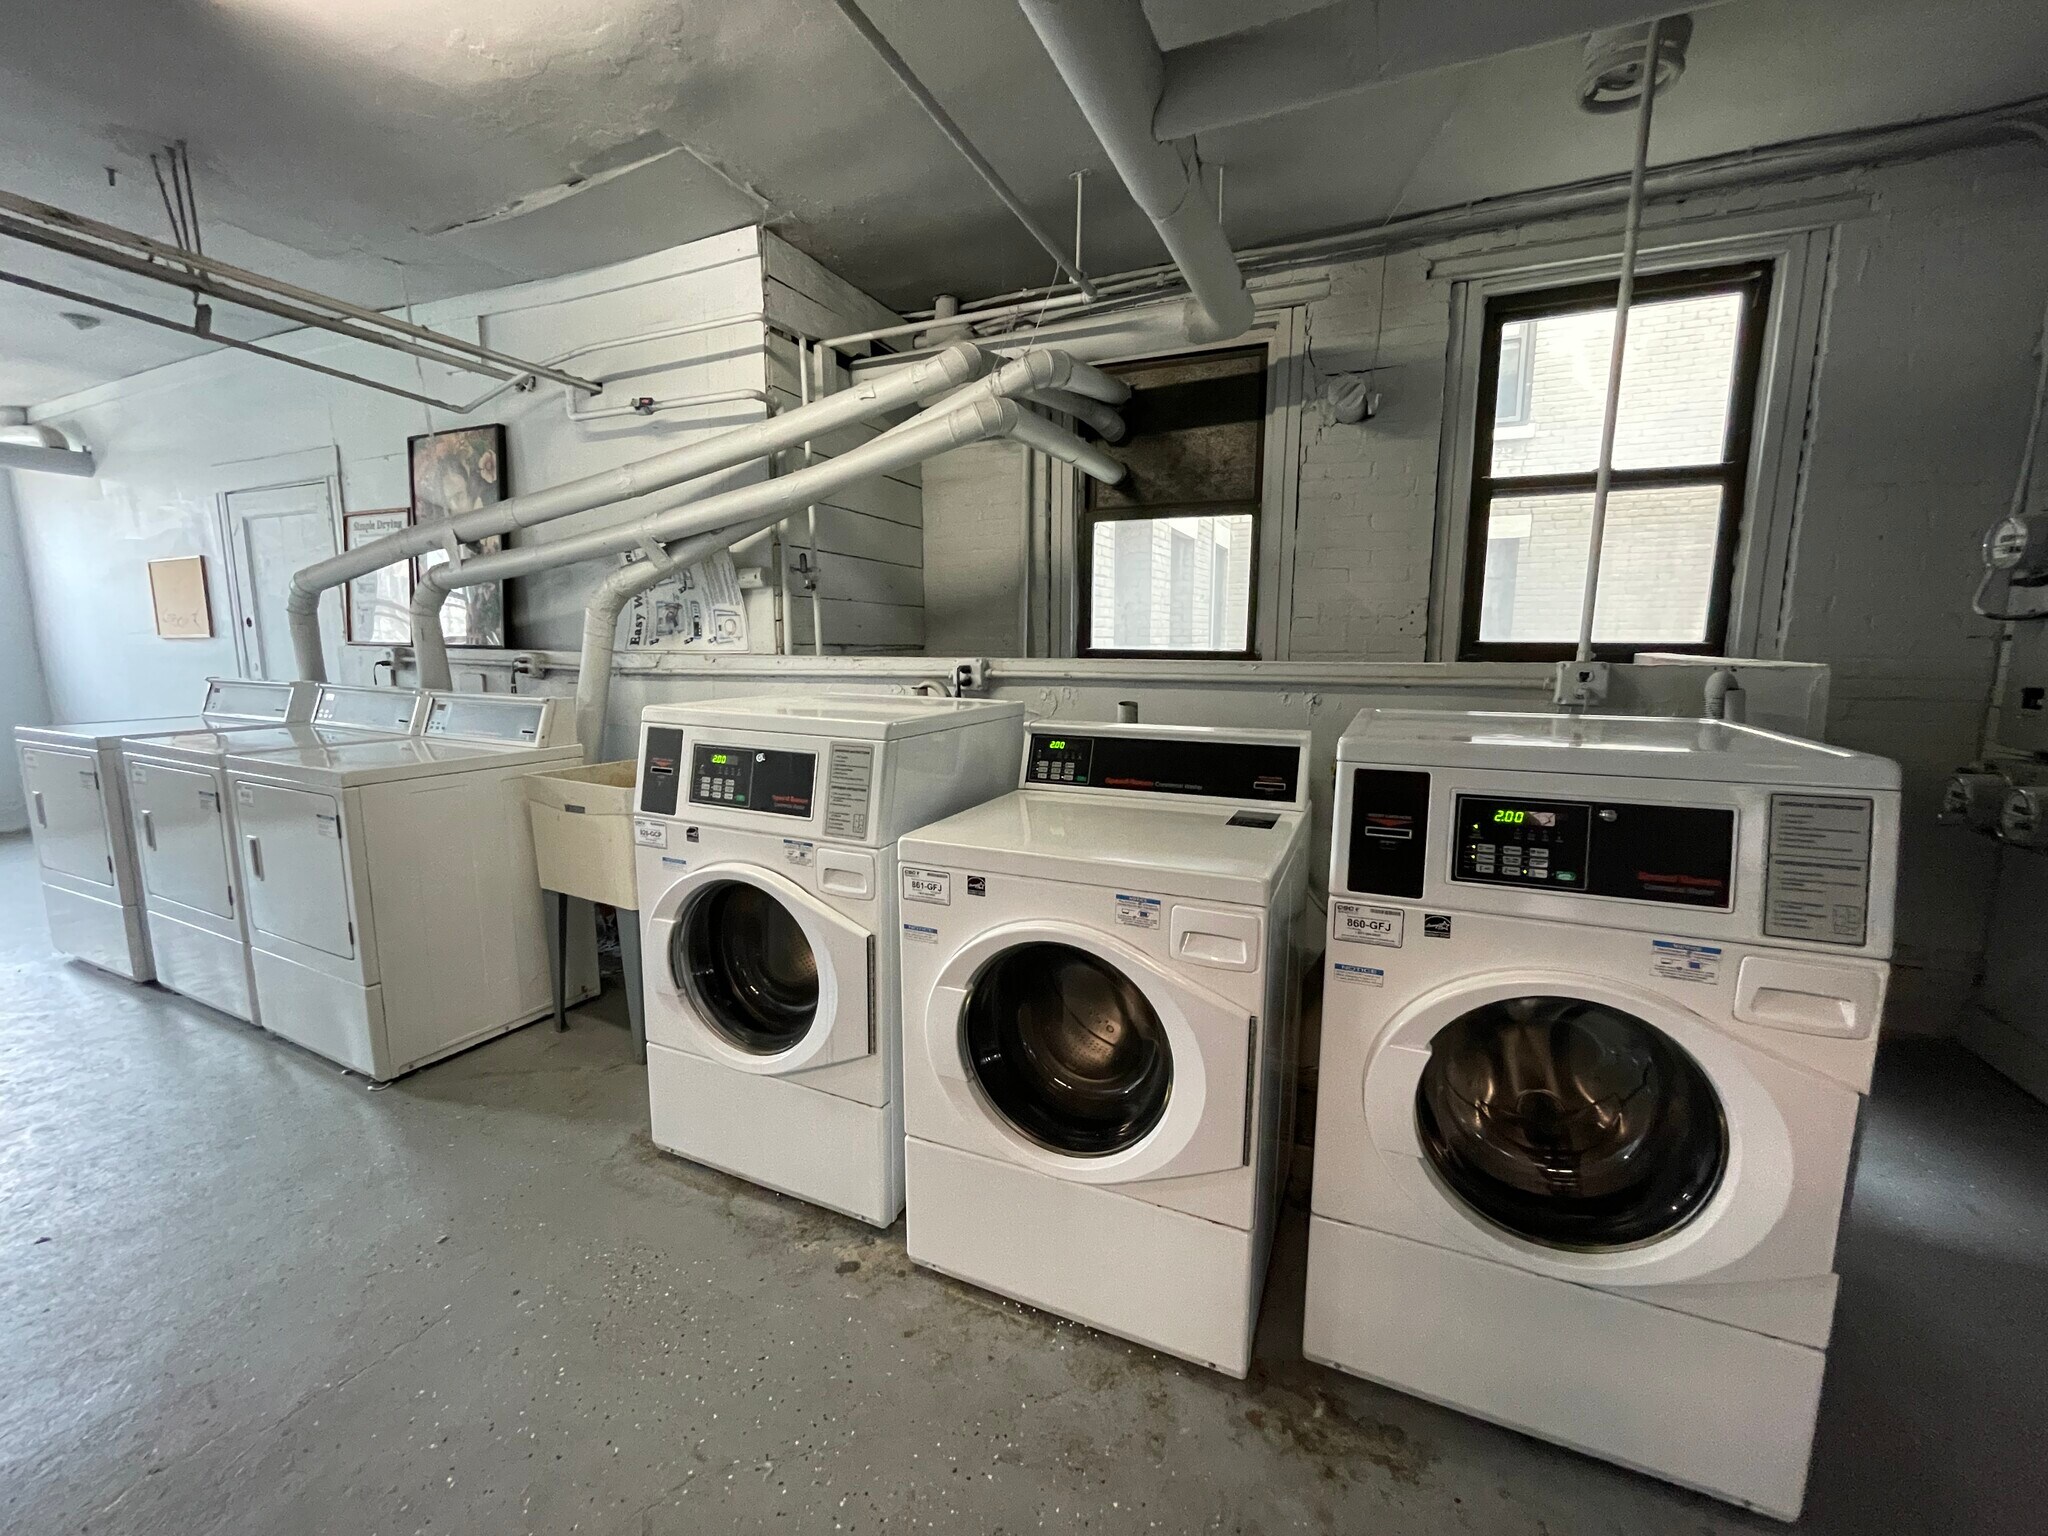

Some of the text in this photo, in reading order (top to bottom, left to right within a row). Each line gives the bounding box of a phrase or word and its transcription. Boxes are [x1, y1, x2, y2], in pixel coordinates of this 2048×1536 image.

[353, 519, 402, 533] Simple Drying
[630, 613, 646, 645] Easy
[1494, 810, 1524, 823] 2.00
[912, 881, 942, 892] 861-GFJ
[1346, 918, 1391, 932] 860-GFJ
